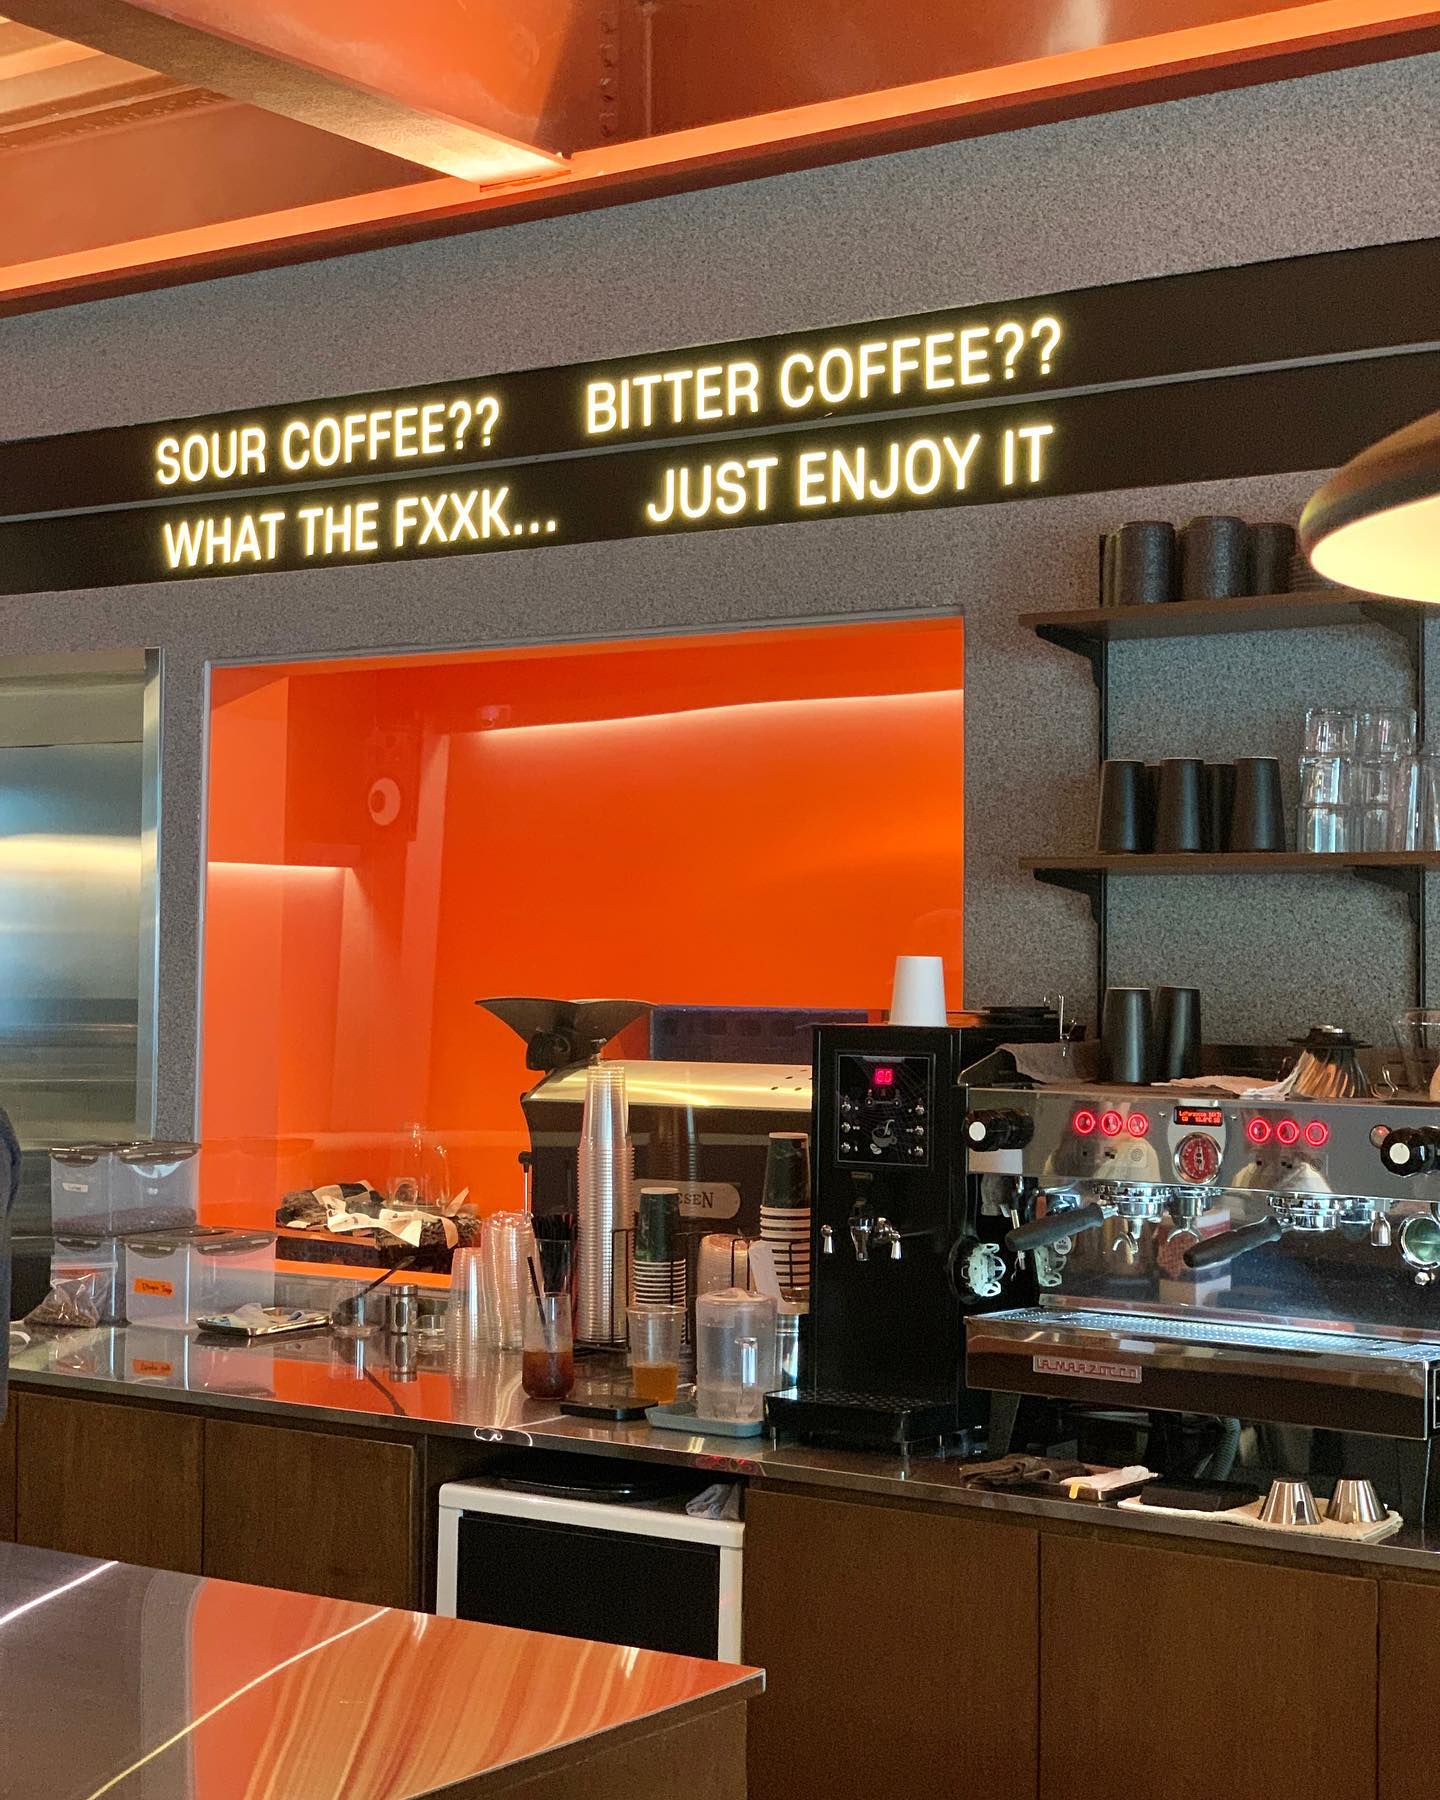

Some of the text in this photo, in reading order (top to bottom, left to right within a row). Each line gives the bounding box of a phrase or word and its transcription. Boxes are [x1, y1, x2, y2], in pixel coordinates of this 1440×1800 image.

[587, 316, 1062, 436] BITTER COFFEE??
[157, 396, 500, 487] SOUR COFFEE??
[646, 424, 1054, 523] JUST ENJOY IT
[164, 486, 557, 569] WHAT THE FXXK...
